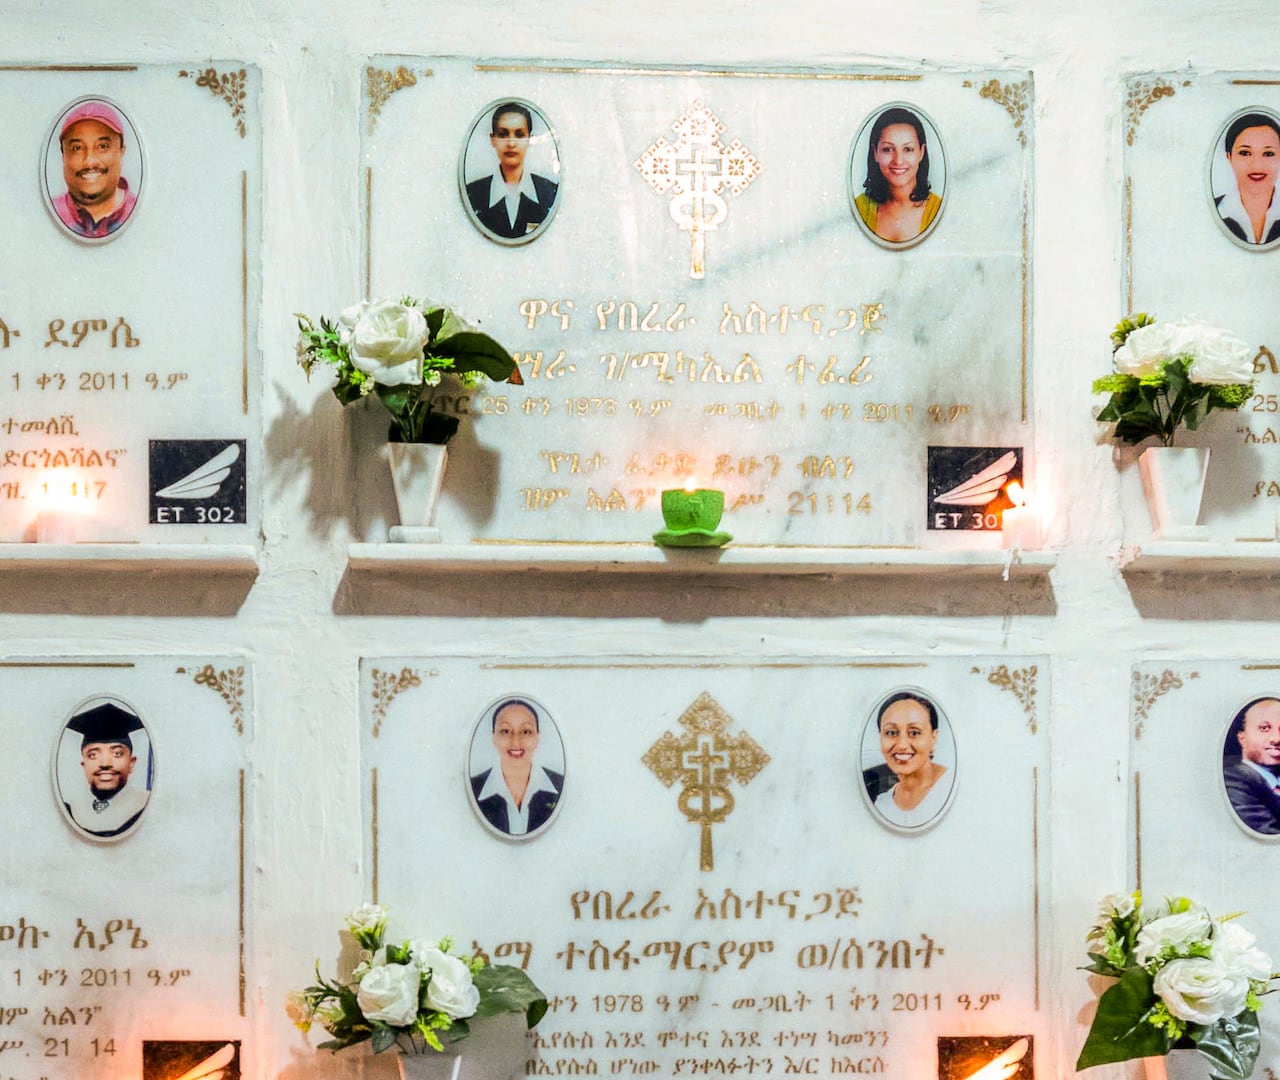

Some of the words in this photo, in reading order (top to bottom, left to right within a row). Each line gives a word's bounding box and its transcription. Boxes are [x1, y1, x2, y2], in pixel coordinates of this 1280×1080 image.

[44, 316, 141, 349] ደምሴ
[1, 415, 79, 437] ተመለሺ
[156, 507, 184, 523] ET
[195, 507, 234, 523] 302
[570, 890, 670, 921] የበረራ
[693, 888, 862, 921] አስተናጋጅ
[72, 917, 149, 952] አያኔ
[556, 939, 774, 973] ተስፋማርያም
